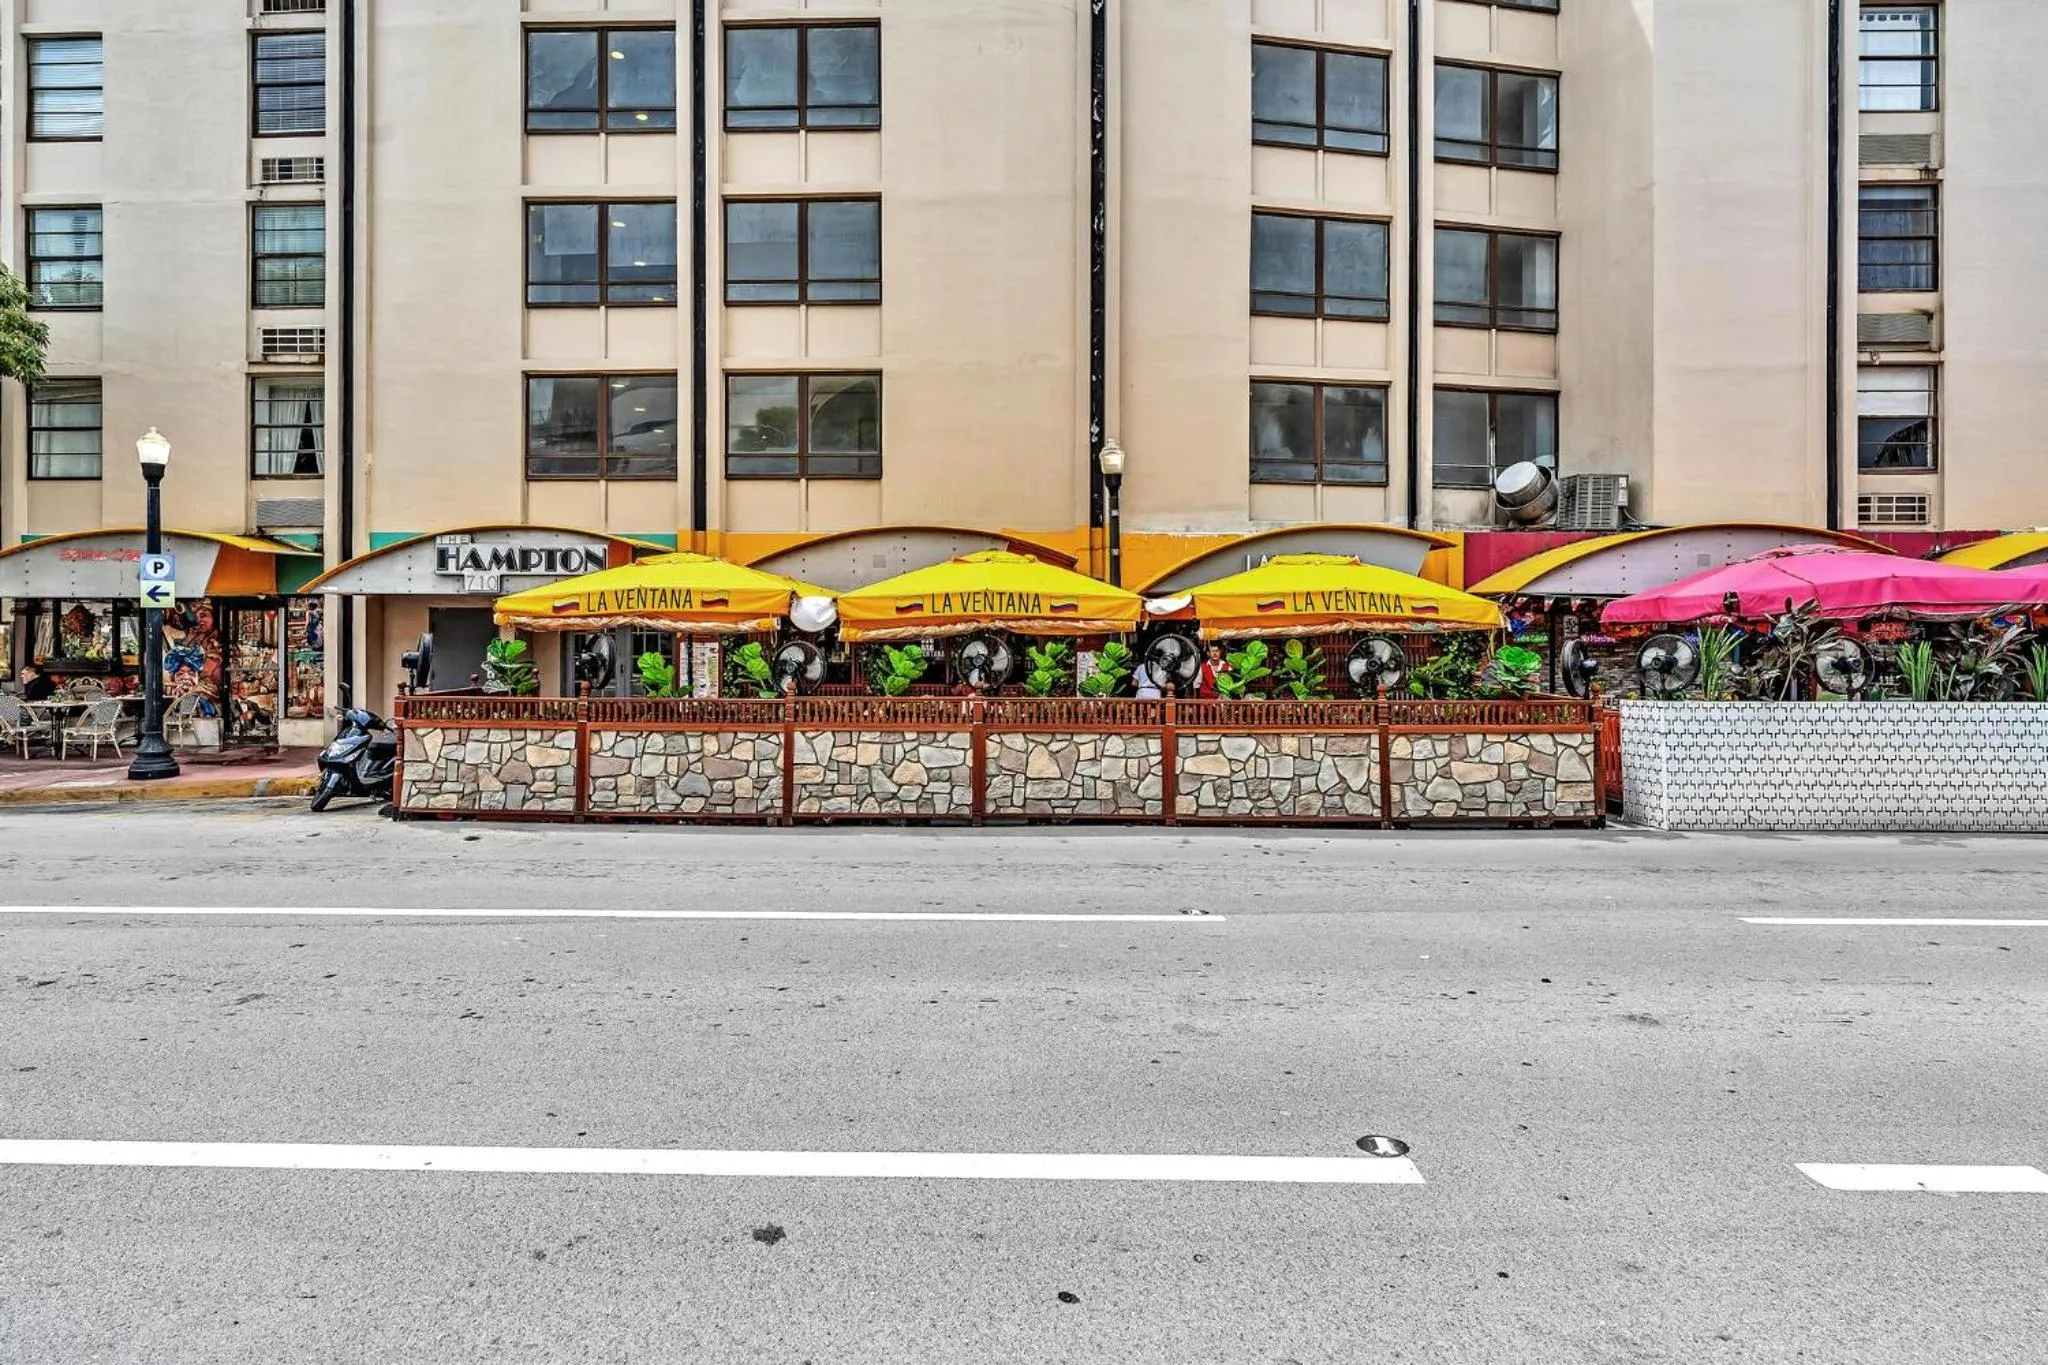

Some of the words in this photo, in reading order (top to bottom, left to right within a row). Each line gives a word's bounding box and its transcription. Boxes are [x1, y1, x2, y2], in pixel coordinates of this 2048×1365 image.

[438, 535, 470, 544] THE
[153, 561, 165, 574] P
[436, 546, 607, 572] HAMPTON
[466, 575, 497, 591] 710
[587, 591, 608, 612] LA
[614, 588, 693, 610] VENTANA
[931, 592, 953, 614] LA
[959, 591, 1042, 614] VENTANA
[1292, 591, 1315, 612] LA
[1321, 590, 1405, 614] VENTANA
